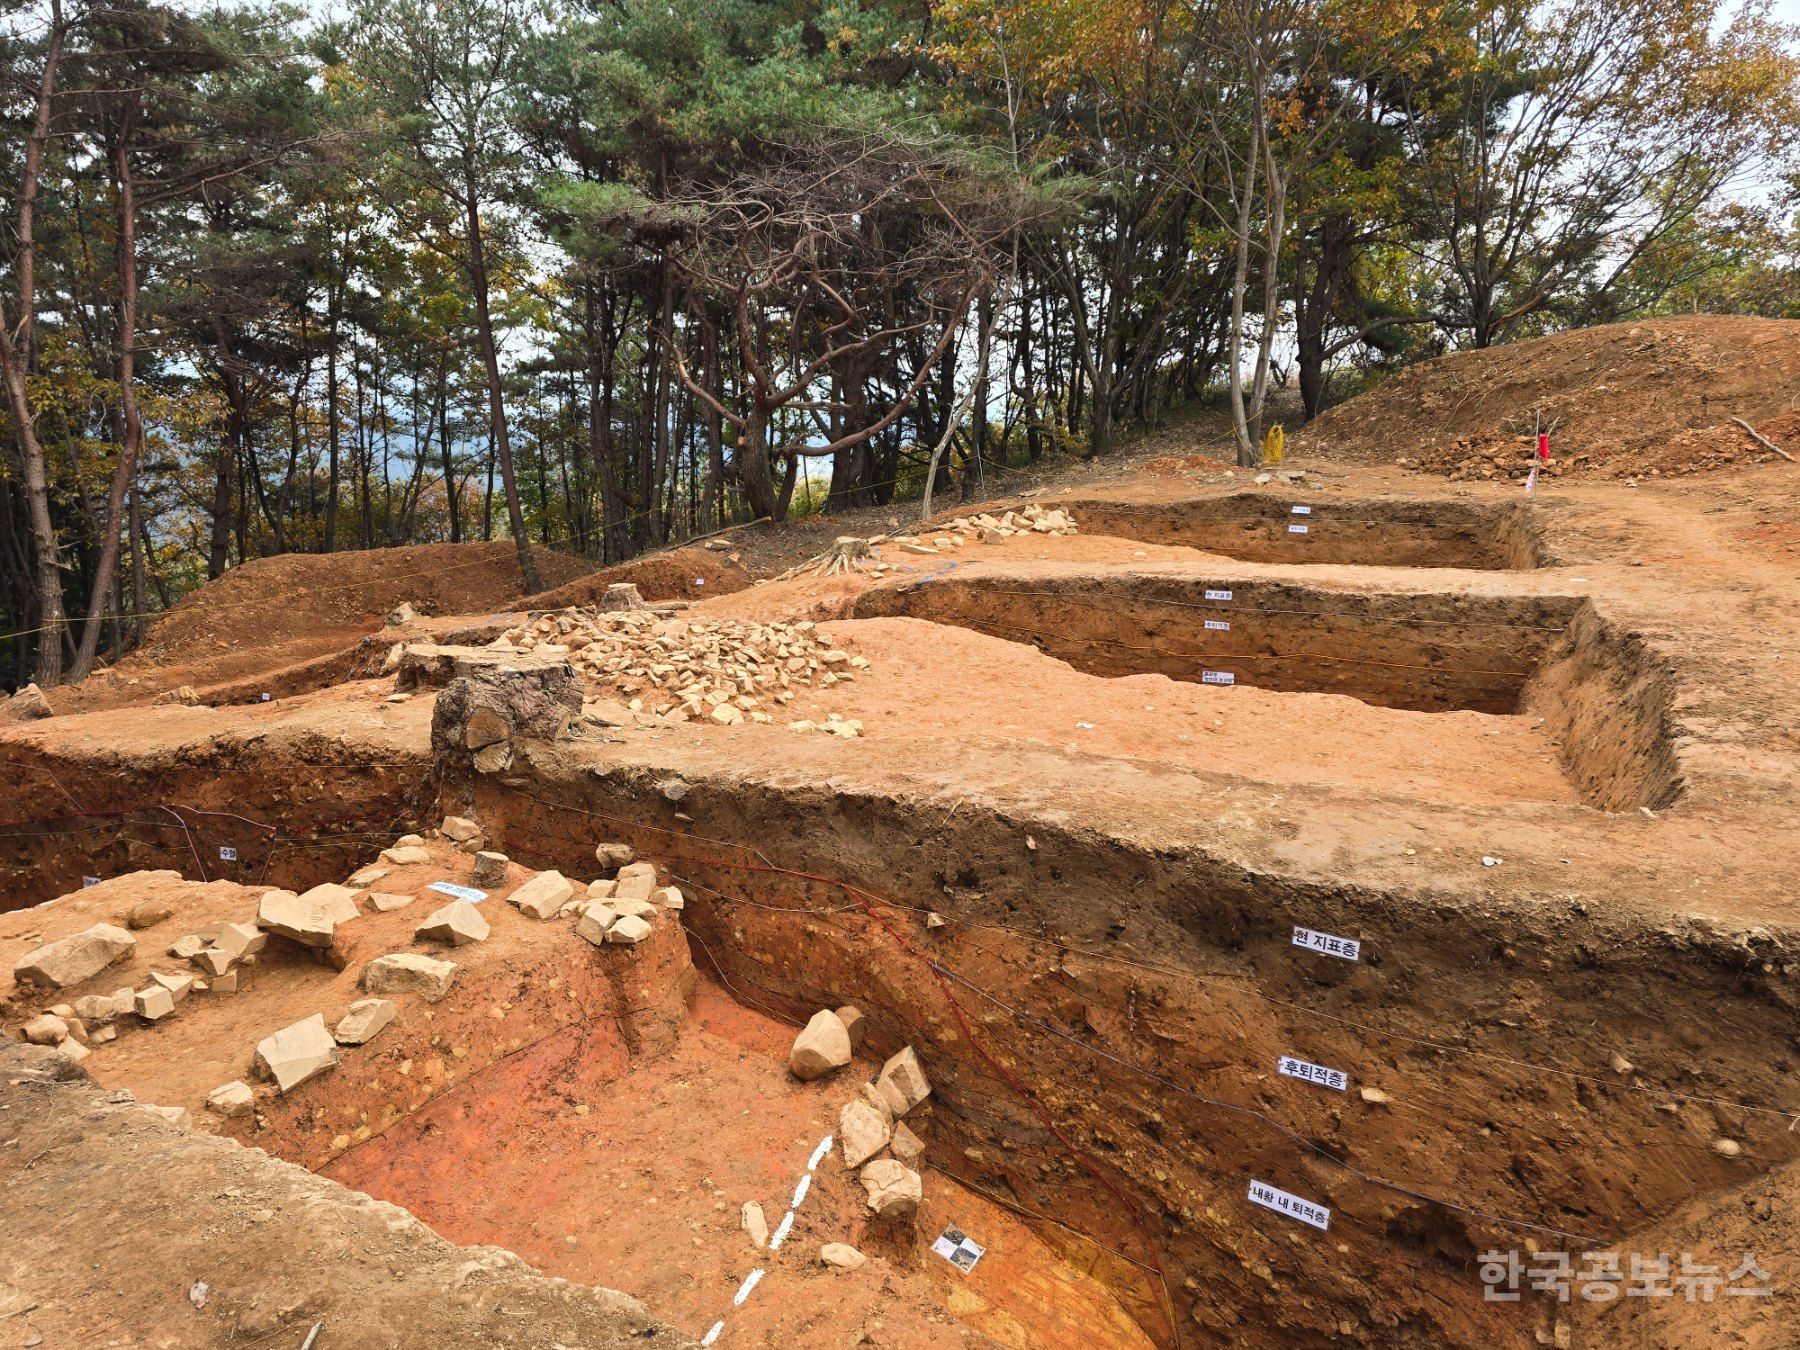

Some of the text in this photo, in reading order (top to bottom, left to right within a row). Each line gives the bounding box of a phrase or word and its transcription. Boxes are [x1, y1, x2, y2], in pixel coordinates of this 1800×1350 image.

[1295, 929, 1357, 957] 현 지표층
[1284, 1060, 1343, 1087] 후퇴적층
[1278, 1196, 1289, 1210] 내
[1291, 1201, 1326, 1224] 퇴적층
